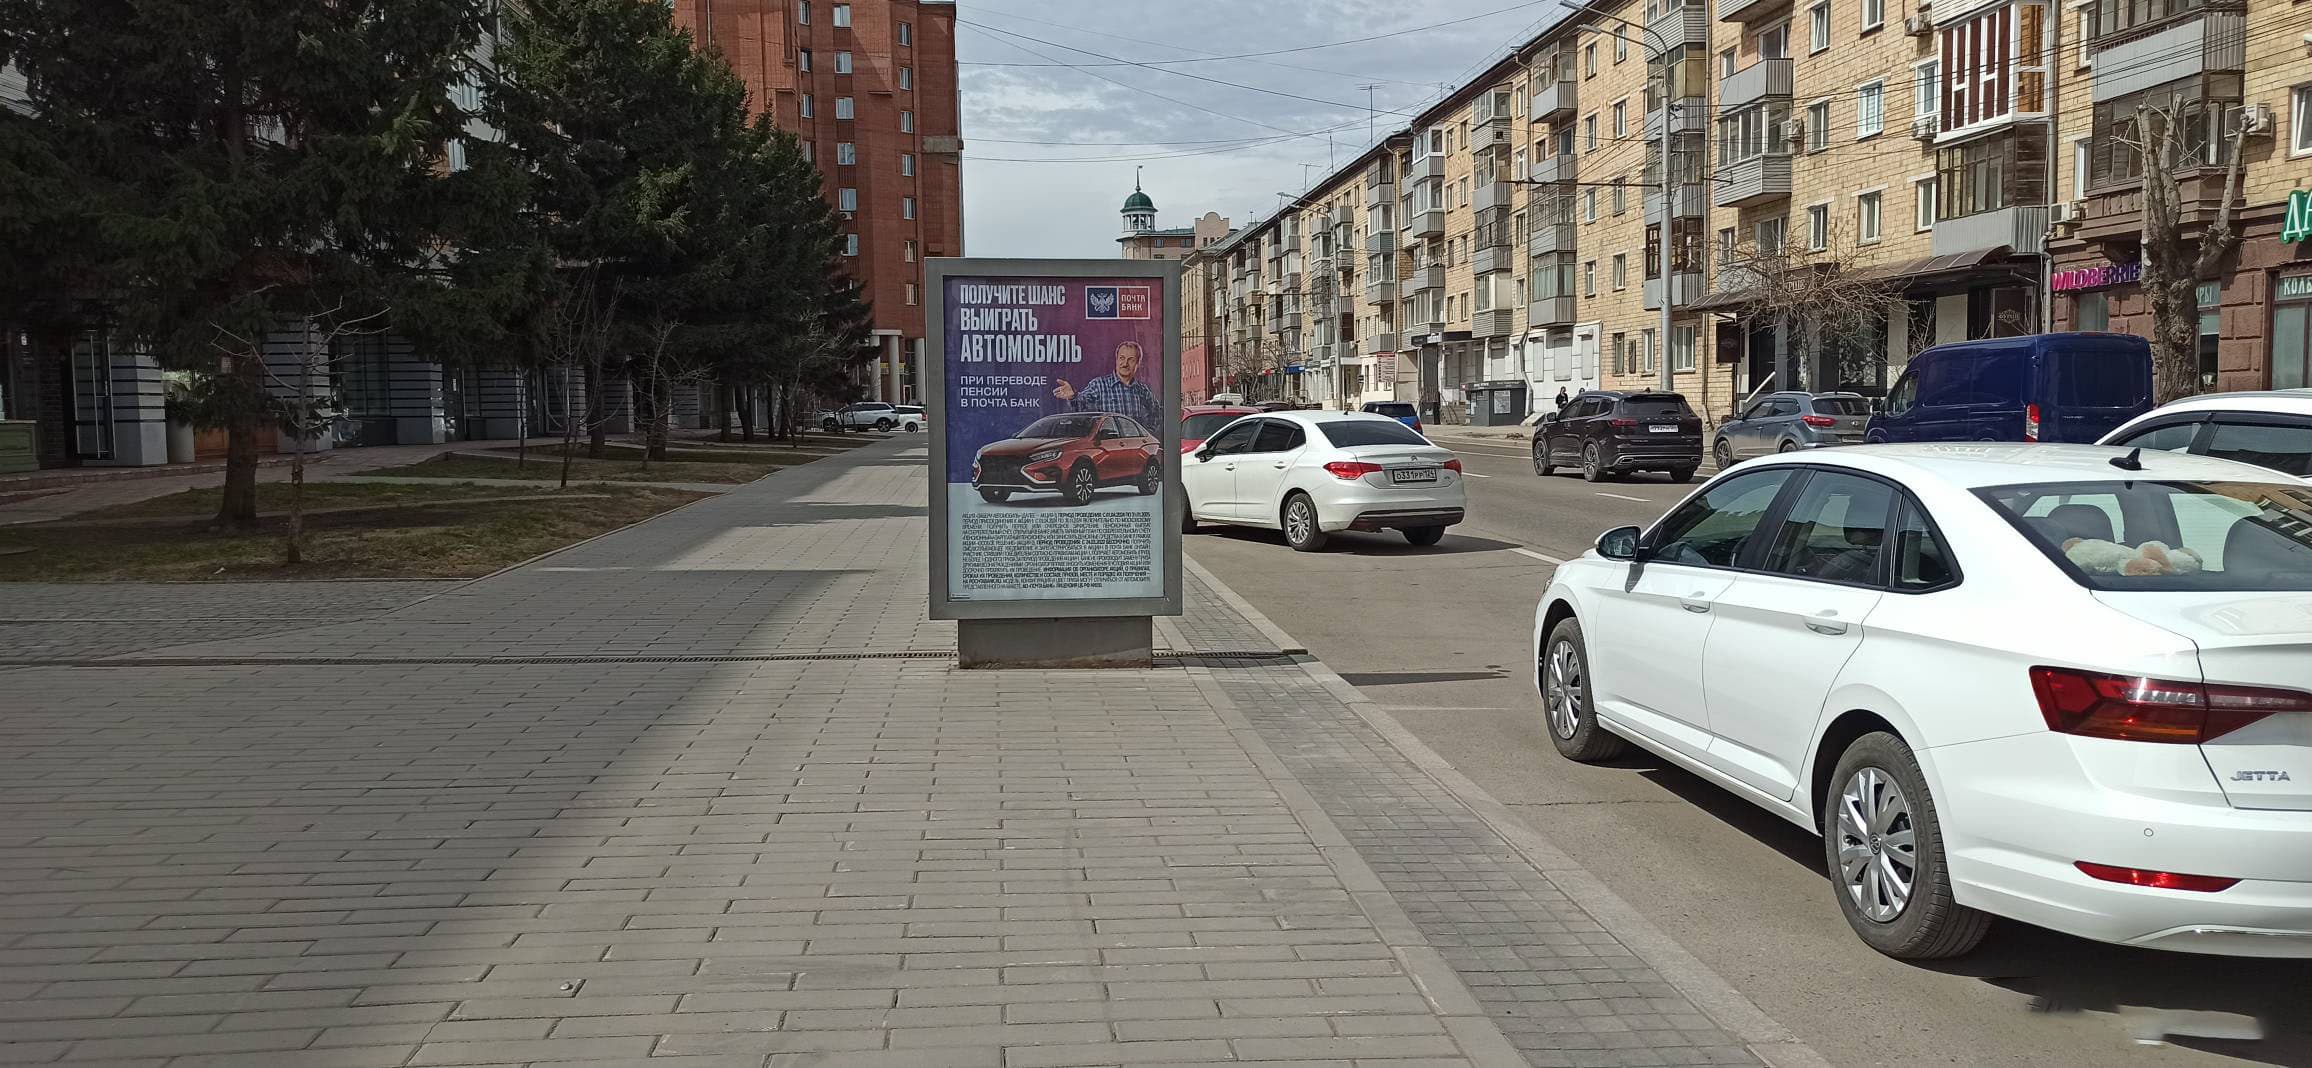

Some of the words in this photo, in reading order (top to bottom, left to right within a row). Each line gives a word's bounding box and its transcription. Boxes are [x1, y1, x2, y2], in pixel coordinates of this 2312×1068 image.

[960, 285, 1025, 305] ПОЛУЧИТЕ
[1028, 285, 1065, 305] ШАНС
[1121, 294, 1146, 303] ПОЧТА
[1121, 303, 1143, 312] БАНК
[960, 308, 1038, 331] ВЫИГРАТЬ
[960, 335, 1082, 362] АВТОМОБИЛЬ
[960, 376, 983, 386] ПРИ
[986, 376, 1047, 386] ПЕРЕВОДЕ
[960, 387, 1008, 397] ПЕНСИИ
[960, 398, 968, 408] В
[971, 398, 1007, 408] ПОЧТА
[1010, 398, 1040, 408] БАНК
[2230, 770, 2291, 782] JETTA
